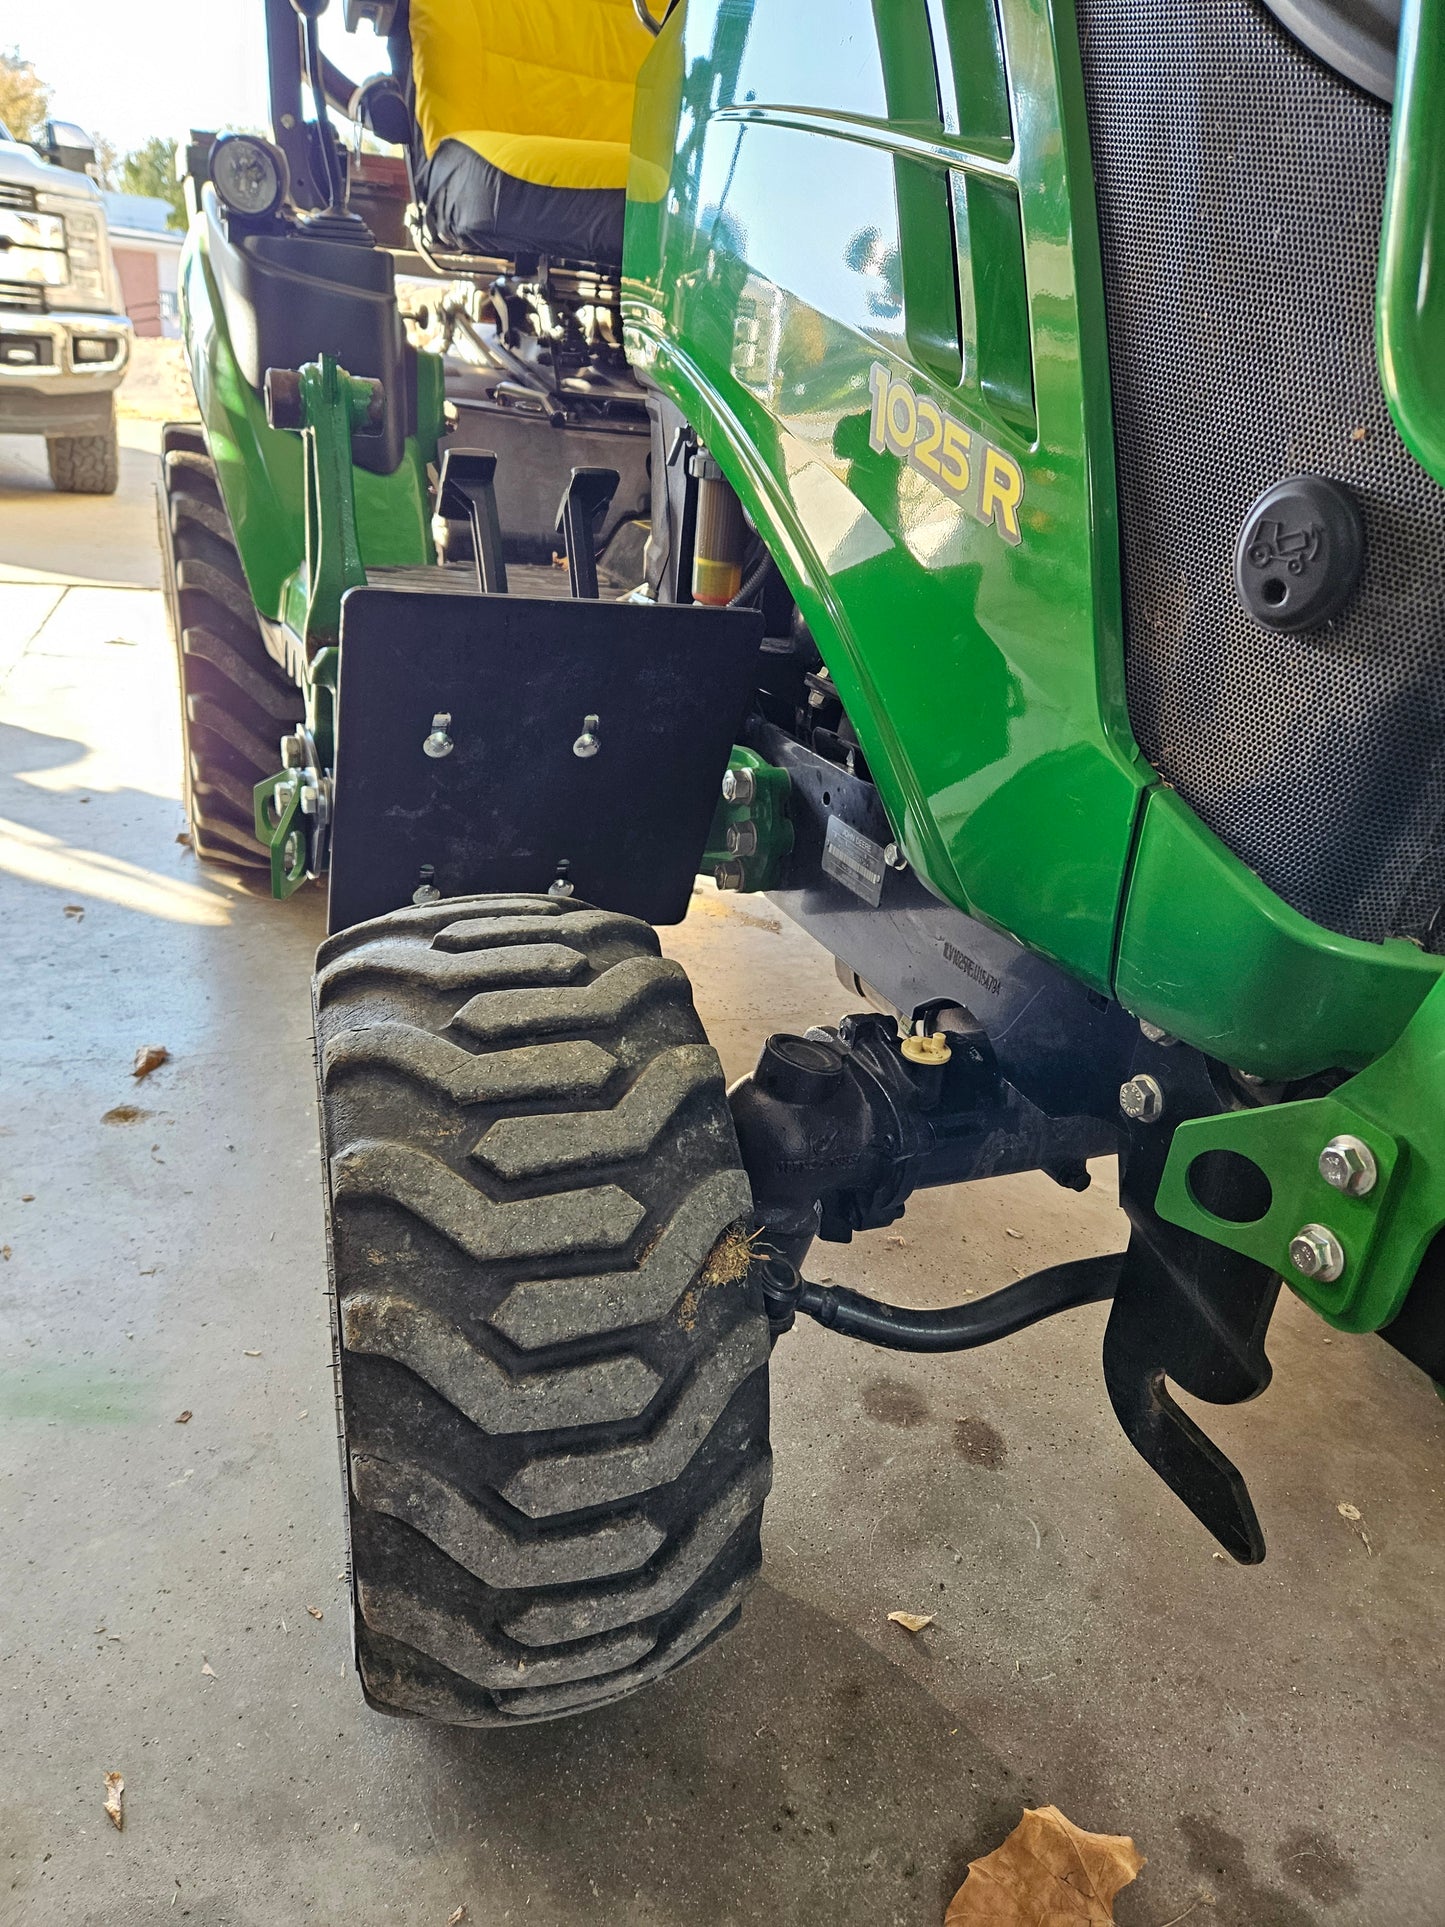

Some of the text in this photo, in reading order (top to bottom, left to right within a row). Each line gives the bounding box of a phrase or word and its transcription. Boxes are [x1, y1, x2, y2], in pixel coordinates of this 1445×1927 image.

[870, 362, 1024, 545] 1025 R
[856, 837, 872, 852] DEERE
